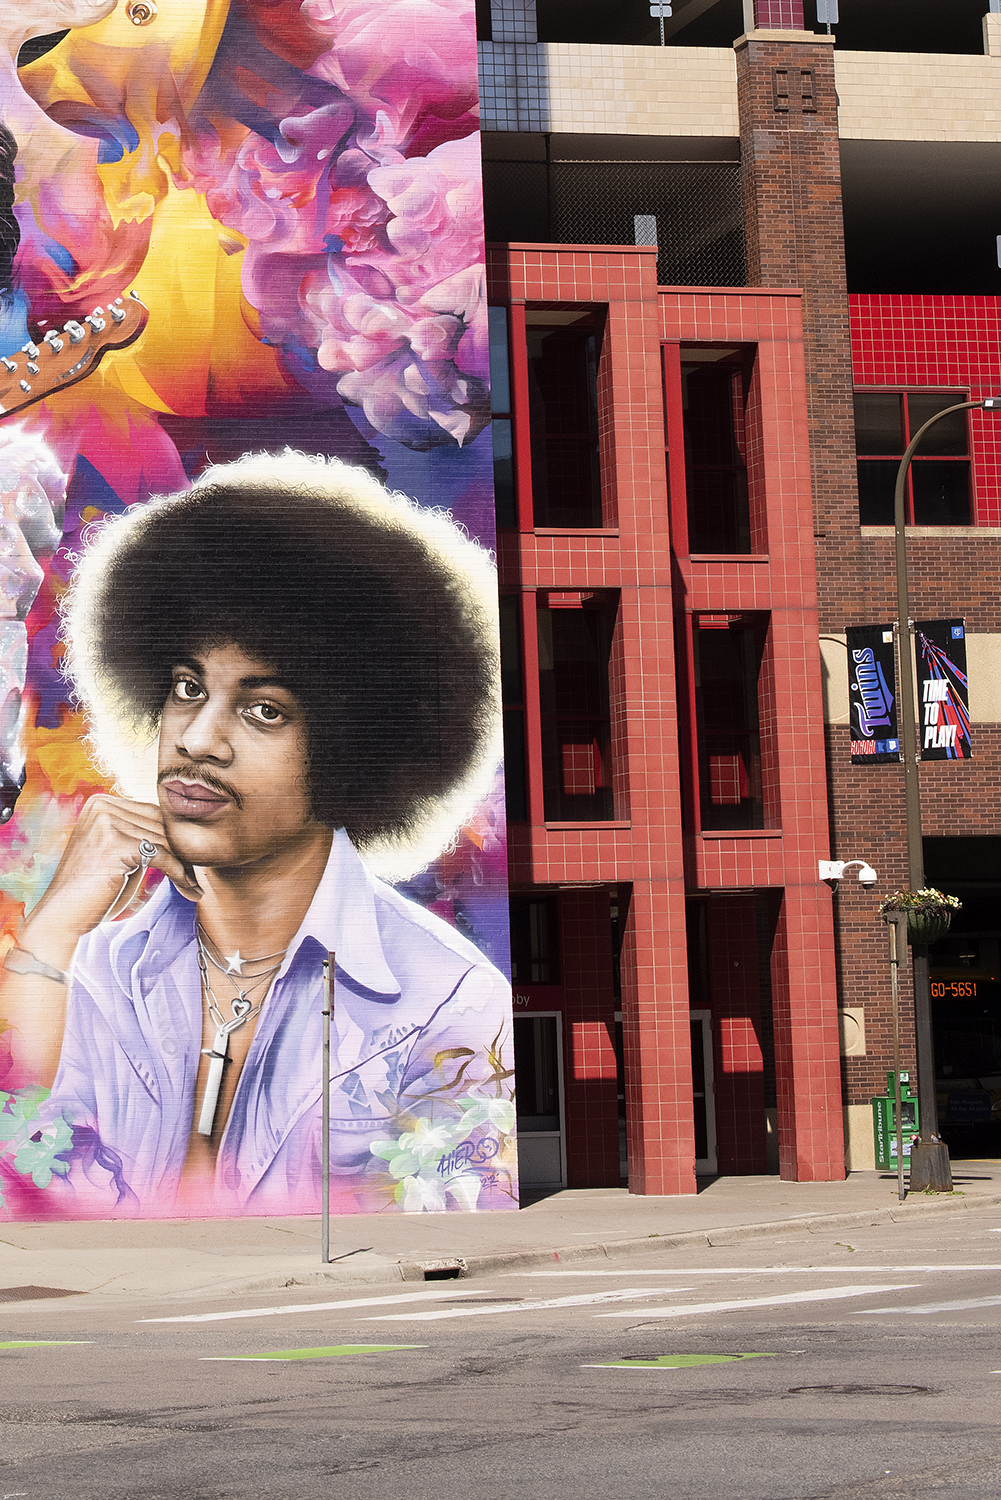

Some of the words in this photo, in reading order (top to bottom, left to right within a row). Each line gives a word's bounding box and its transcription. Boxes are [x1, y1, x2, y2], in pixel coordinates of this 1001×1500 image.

[851, 647, 892, 737] Twins
[923, 679, 948, 702] TIME
[924, 703, 939, 725] TO
[924, 725, 957, 749] PLAY!
